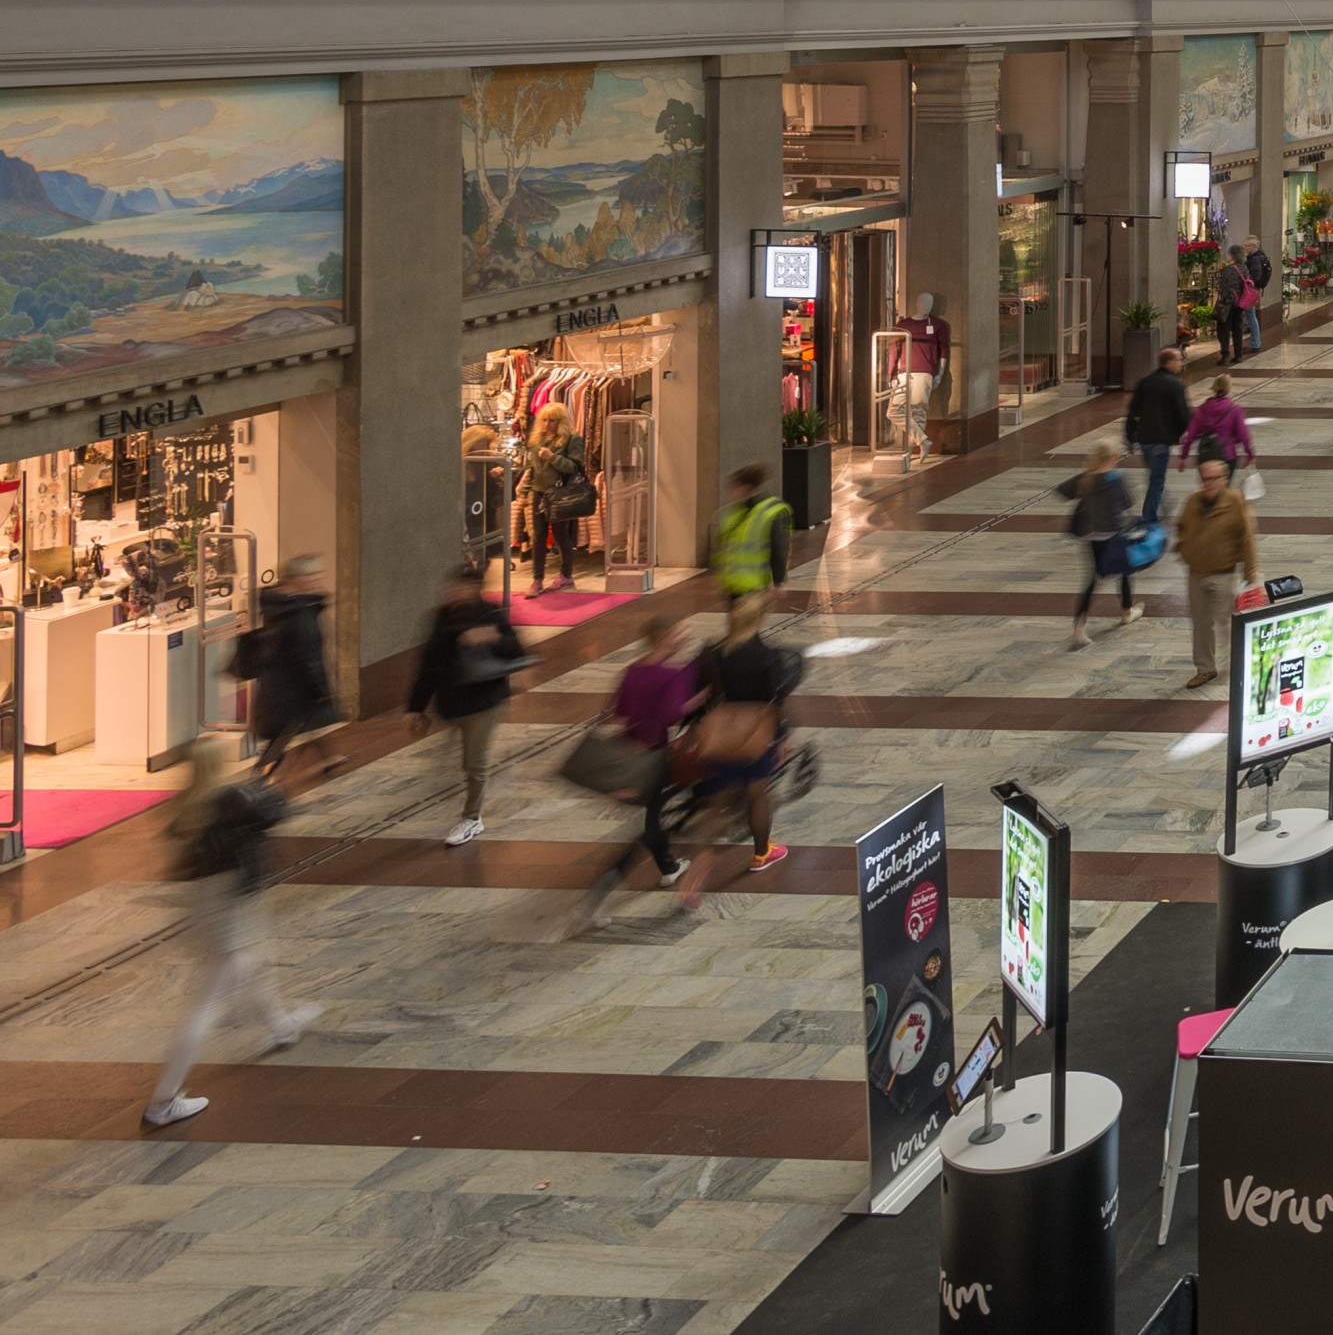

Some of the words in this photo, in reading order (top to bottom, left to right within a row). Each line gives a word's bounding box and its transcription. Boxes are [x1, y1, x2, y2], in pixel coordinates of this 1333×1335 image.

[555, 302, 621, 335] ENGLA
[98, 393, 205, 439] ENGLA
[1260, 624, 1292, 640] Lyssna
[1260, 640, 1276, 652] det
[1306, 699, 1326, 715] eko
[865, 832, 911, 869] Provsmaka
[912, 820, 928, 836] vår
[866, 829, 941, 893] ekologiska
[1254, 936, 1279, 949] äntl
[890, 1113, 939, 1173] Verum
